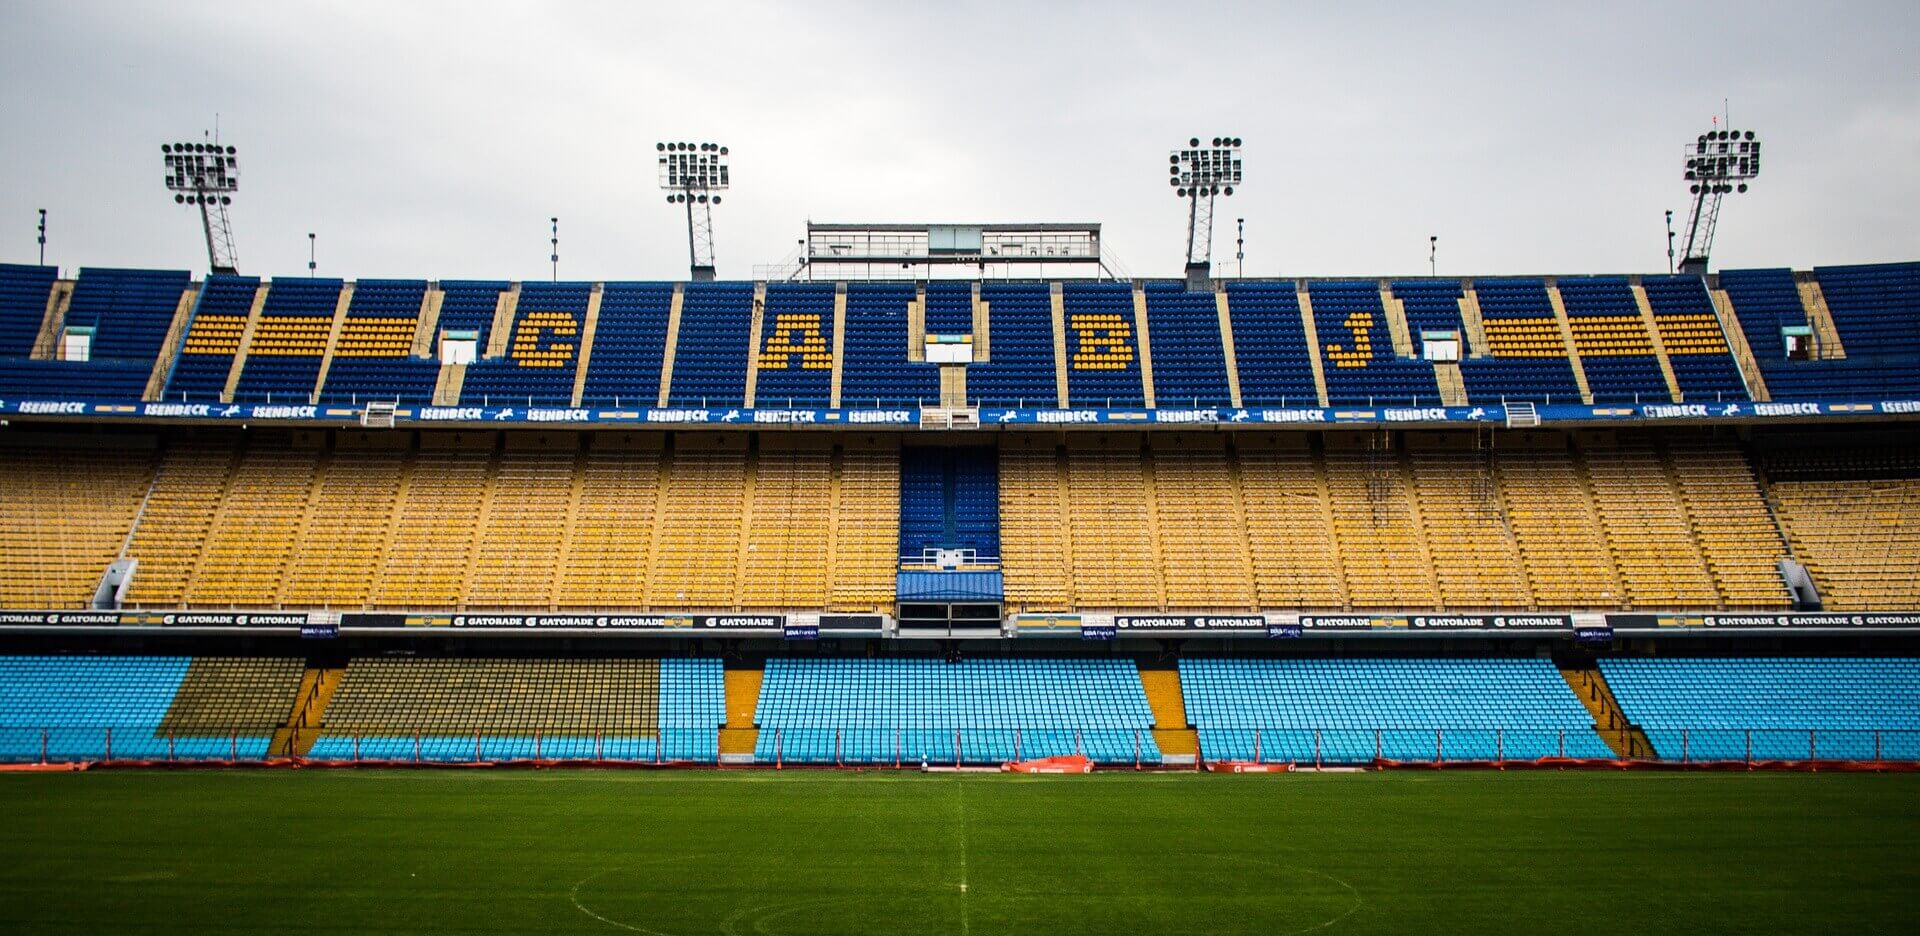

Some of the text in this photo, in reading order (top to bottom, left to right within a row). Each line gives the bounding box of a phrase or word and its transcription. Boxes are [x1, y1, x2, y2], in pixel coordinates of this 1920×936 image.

[512, 312, 1373, 369] C A B J
[18, 401, 86, 414] ISENBECK
[144, 403, 210, 416] ISENBECK
[252, 405, 317, 419] ISENBECK
[419, 407, 483, 421] ISENBECK
[526, 407, 590, 422] ISENBECK
[646, 408, 710, 423] ISENBECK
[848, 410, 910, 423] ISENBECK
[1036, 410, 1098, 424] ISENBECK
[1155, 409, 1219, 423] ISENBECK
[1262, 409, 1326, 423] ISENBECK
[1383, 407, 1448, 422] ISENBECK
[1753, 402, 1821, 416] ISENBECK
[0, 615, 43, 623] TORADE
[62, 615, 118, 623] GATORADE
[178, 615, 232, 624] GATORADE
[250, 616, 305, 625] GATORADE
[468, 617, 522, 626] GATORADE
[540, 617, 593, 626] GATORADE
[610, 617, 665, 626] GATORADE
[720, 617, 774, 626] GATORADE
[1132, 618, 1186, 627] GATORADE
[1208, 618, 1262, 627] GATORADE
[1316, 617, 1370, 626] GATORADE
[1429, 617, 1483, 626] GATORADE
[1508, 617, 1563, 626] GATORADE
[1719, 617, 1774, 626] GATORADE
[1792, 616, 1849, 625] GATORADE
[1867, 616, 1920, 625] GATORAD
